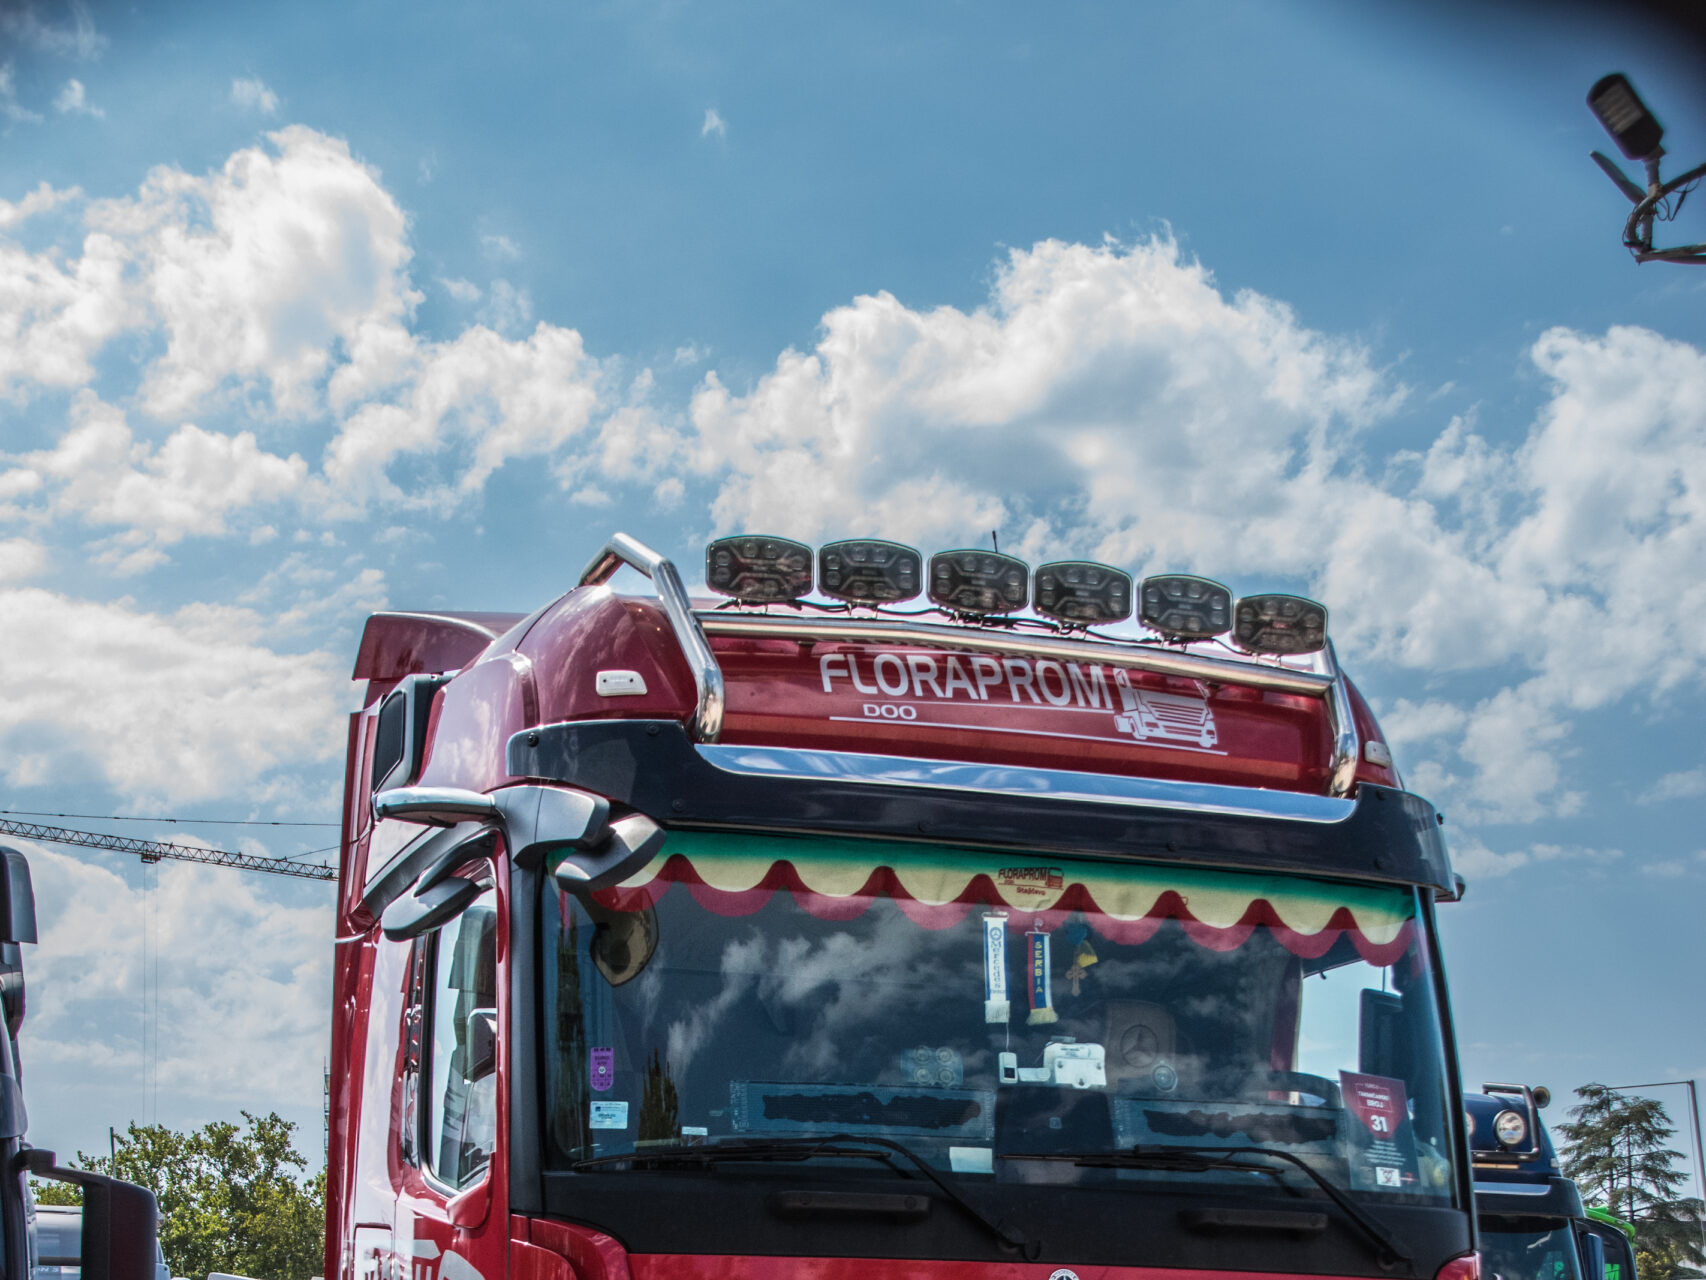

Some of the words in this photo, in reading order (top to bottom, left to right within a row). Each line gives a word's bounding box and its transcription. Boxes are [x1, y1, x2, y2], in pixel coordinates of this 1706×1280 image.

[820, 653, 1114, 709] FLORAPROM
[863, 703, 917, 720] DOO
[1034, 941, 1044, 993] SERBIA
[1370, 1114, 1389, 1133] 31
